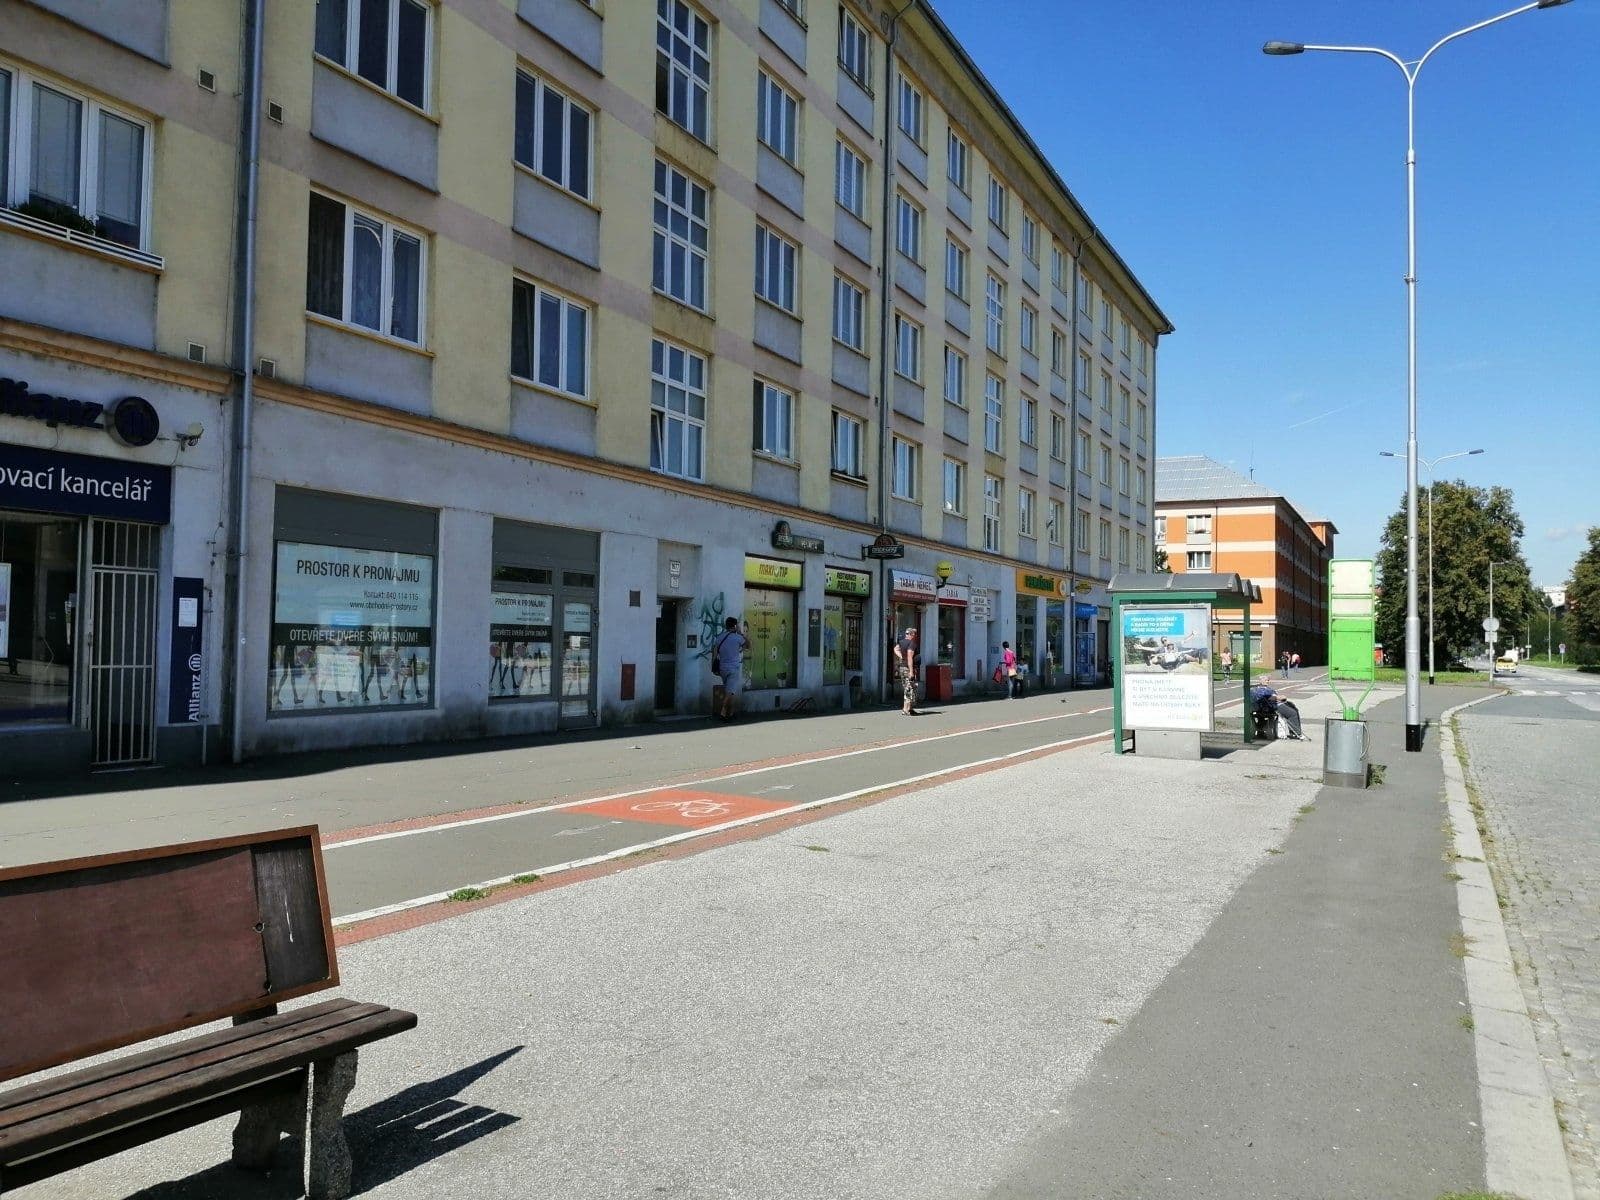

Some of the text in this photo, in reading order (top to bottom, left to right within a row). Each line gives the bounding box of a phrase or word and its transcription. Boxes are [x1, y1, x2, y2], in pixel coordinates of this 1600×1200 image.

[60, 468, 152, 502] kancelář
[296, 559, 350, 578] PROSTOR
[353, 564, 360, 579] K
[188, 674, 200, 722] Allianz
